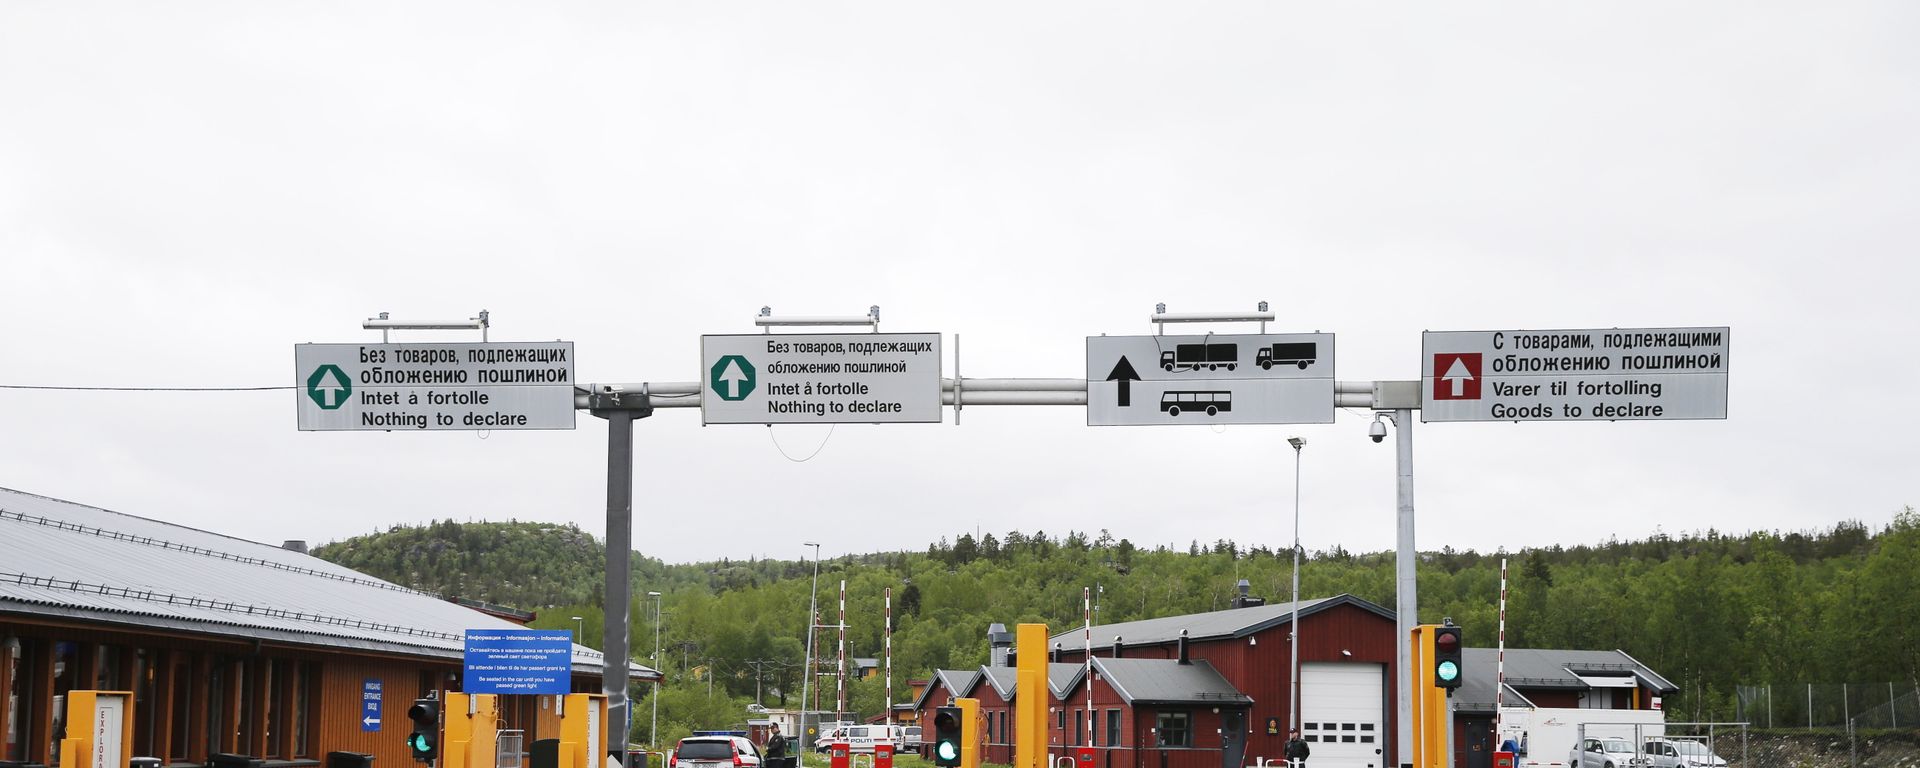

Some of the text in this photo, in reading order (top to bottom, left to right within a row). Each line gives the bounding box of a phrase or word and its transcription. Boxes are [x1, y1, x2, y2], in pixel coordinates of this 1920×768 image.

[768, 341, 931, 356] Без товаров, подлежащих
[1493, 331, 1721, 351] С товарами, подлежащими
[360, 347, 566, 366] Без товаров, подлежащих
[1493, 353, 1720, 372] обложению пошлиной
[768, 360, 906, 373] обложению пошлиной
[361, 368, 567, 383] обложению пошлиной
[768, 382, 868, 395] Intet å fortolle
[1493, 380, 1661, 398] Varer til fortolling
[362, 391, 488, 405] Intet å fortolle
[769, 400, 901, 416] Nothing to declare
[1492, 402, 1663, 418] Goods to declare
[362, 412, 527, 429] Nothing to declare
